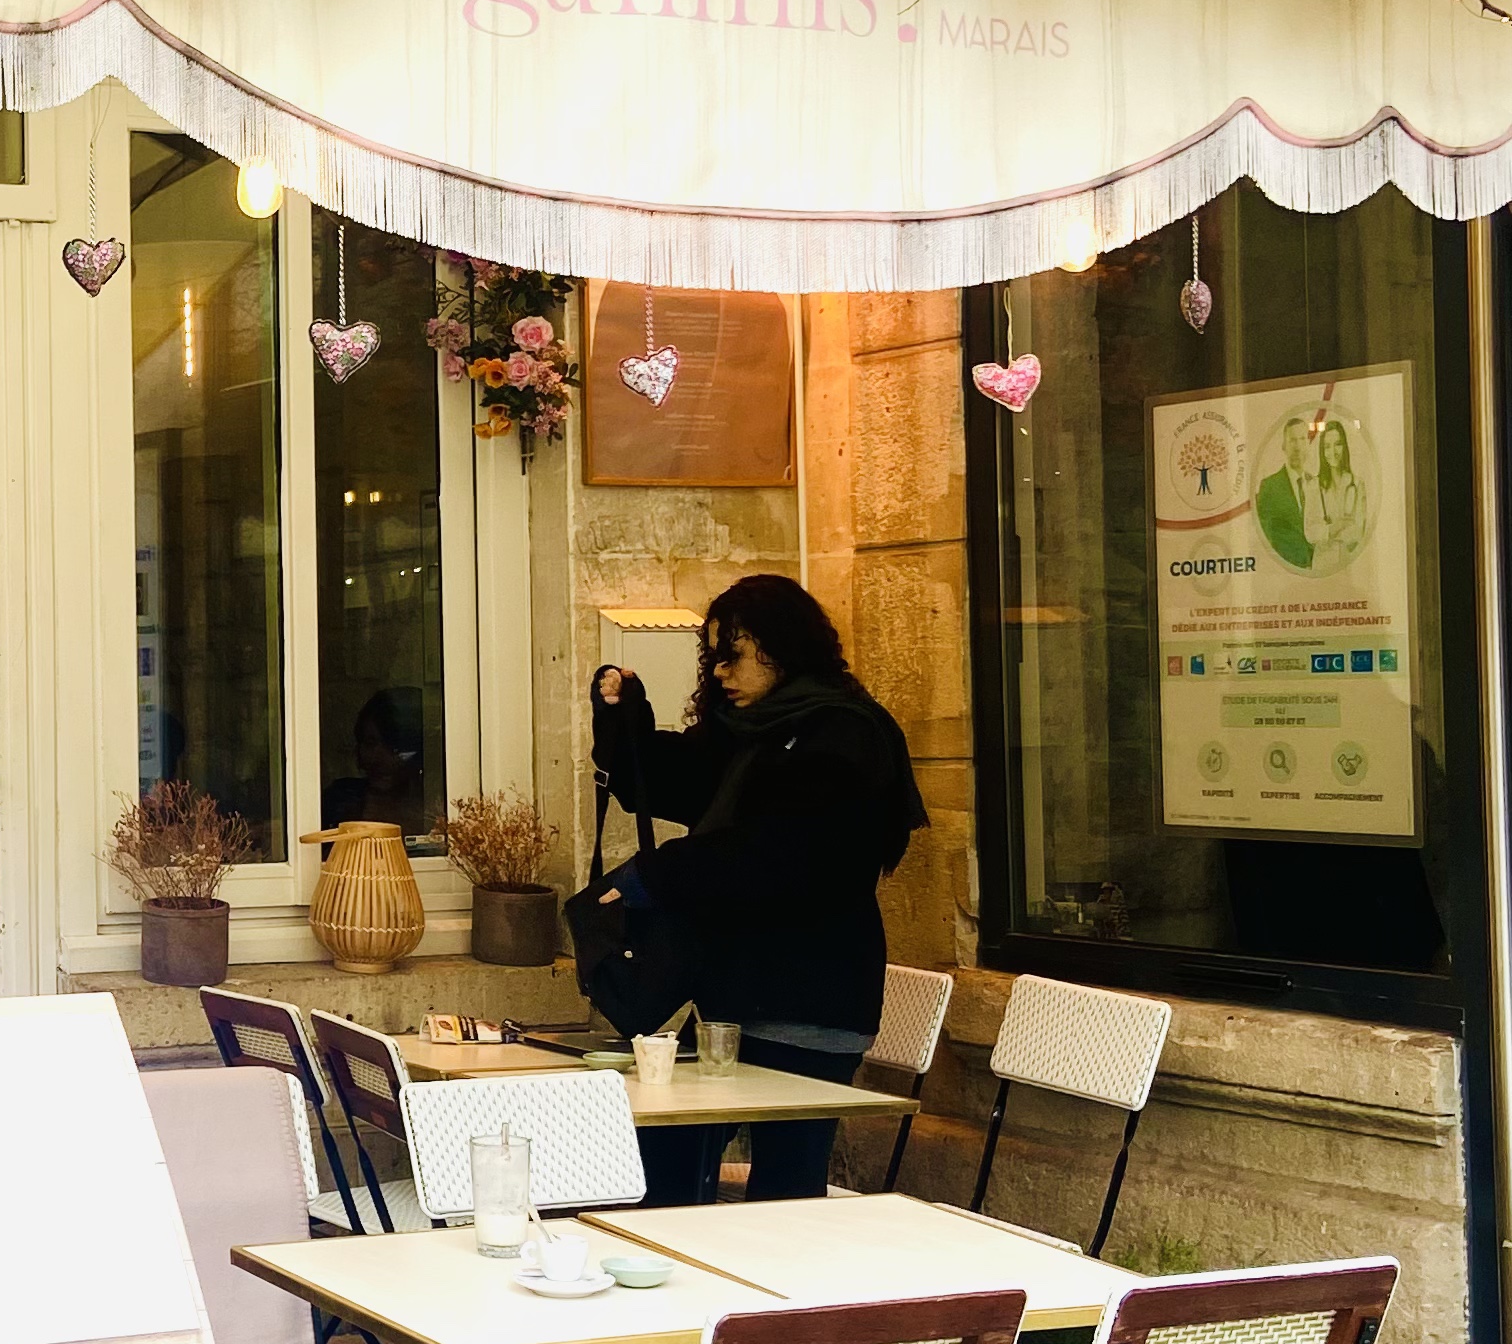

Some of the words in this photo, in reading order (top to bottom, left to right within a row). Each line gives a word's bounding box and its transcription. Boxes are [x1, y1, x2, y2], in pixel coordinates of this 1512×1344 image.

[939, 11, 1071, 58] MARAIS
[1170, 556, 1256, 577] COURTIER
[1294, 618, 1314, 629] AUX
[1314, 656, 1342, 670] CIC
